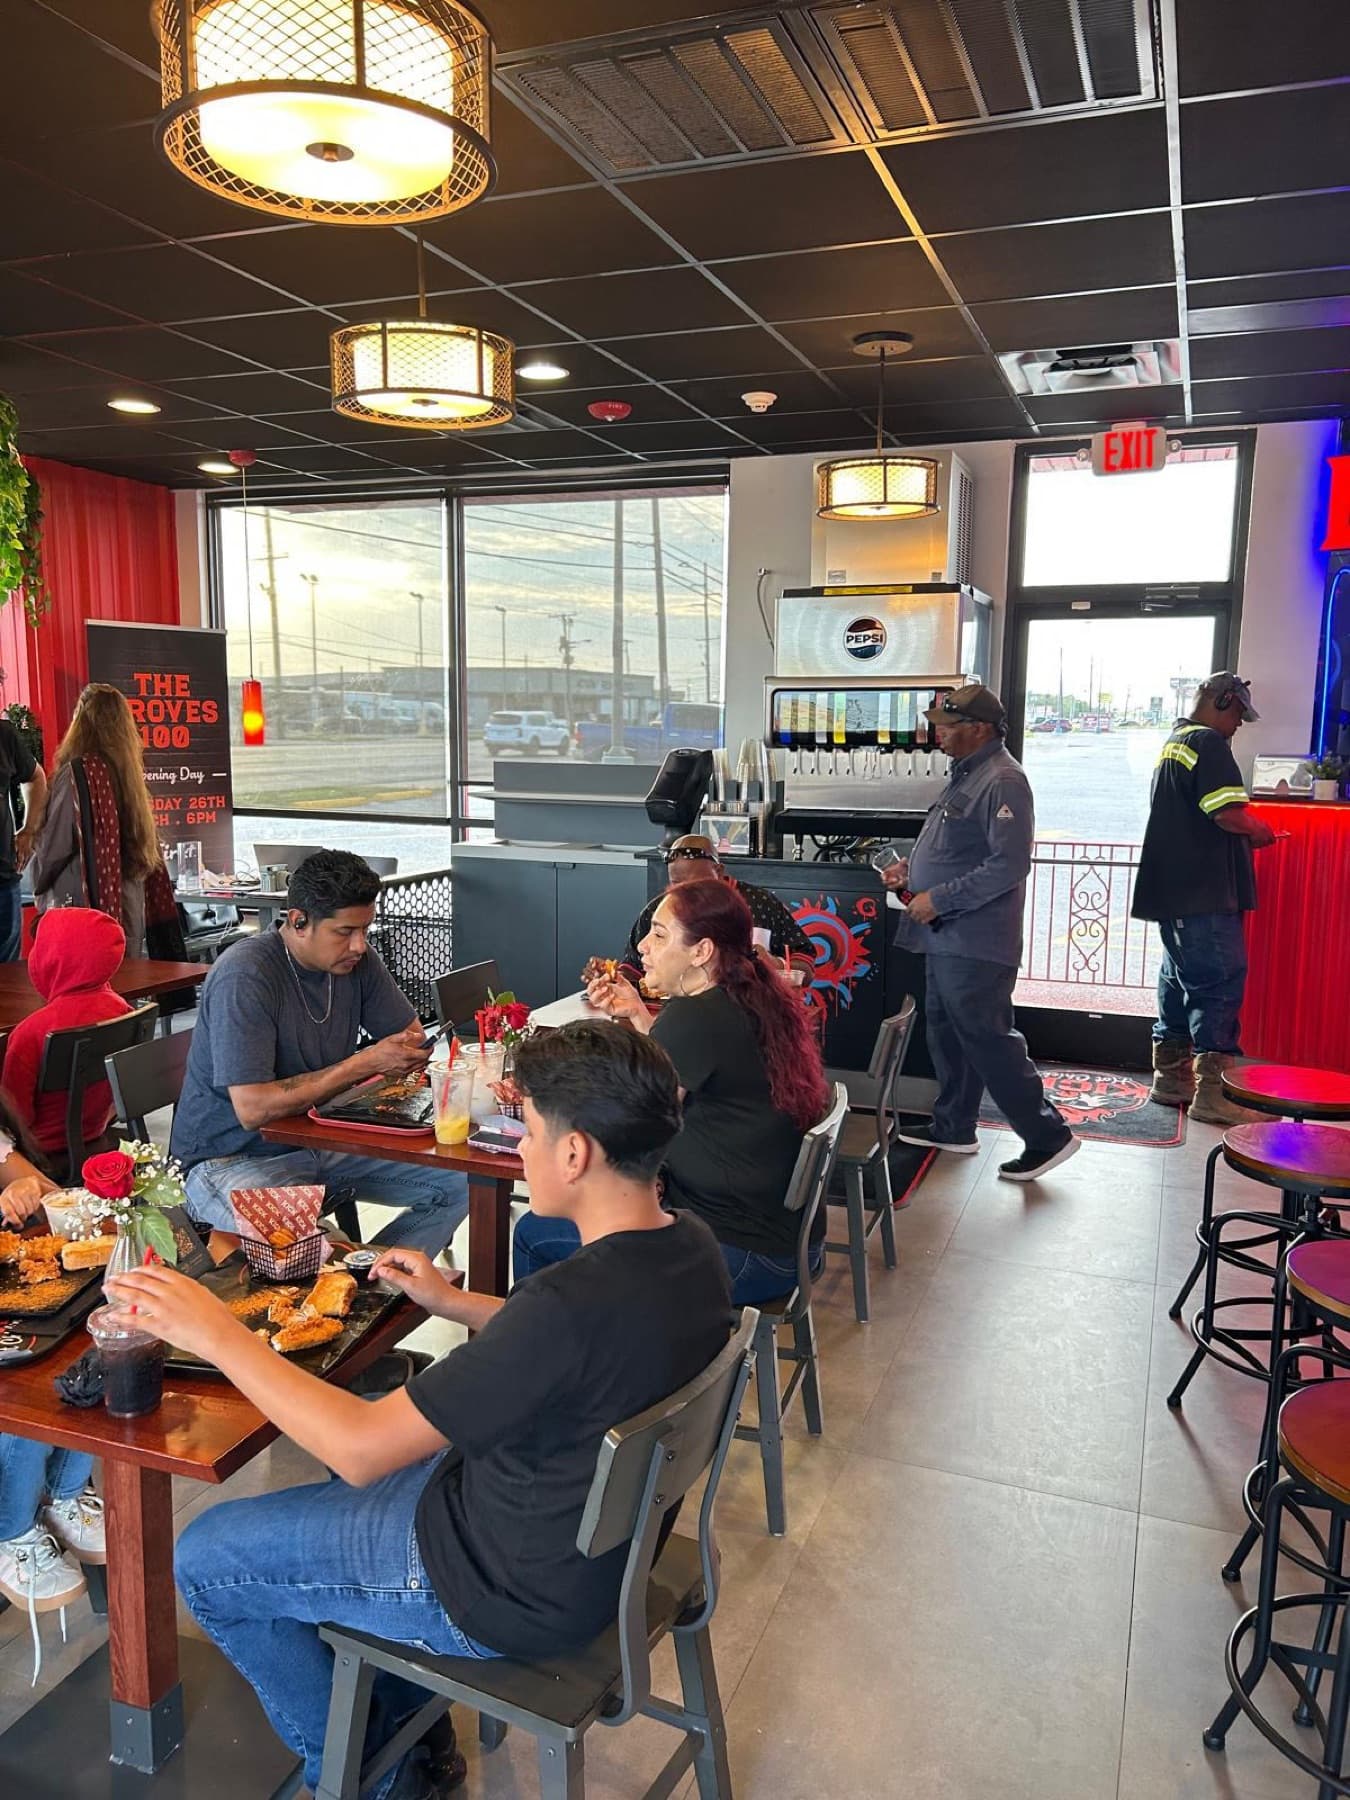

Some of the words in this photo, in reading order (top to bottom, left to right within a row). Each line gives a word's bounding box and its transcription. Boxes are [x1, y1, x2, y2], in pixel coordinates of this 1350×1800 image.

[1104, 428, 1158, 472] EXIT
[846, 632, 884, 644] PEPSI
[133, 672, 191, 697] THE
[127, 698, 218, 723] ROVES
[139, 724, 190, 749] 100
[180, 766, 205, 784] Day
[189, 796, 225, 809] 26TH
[187, 811, 217, 824] 6PM
